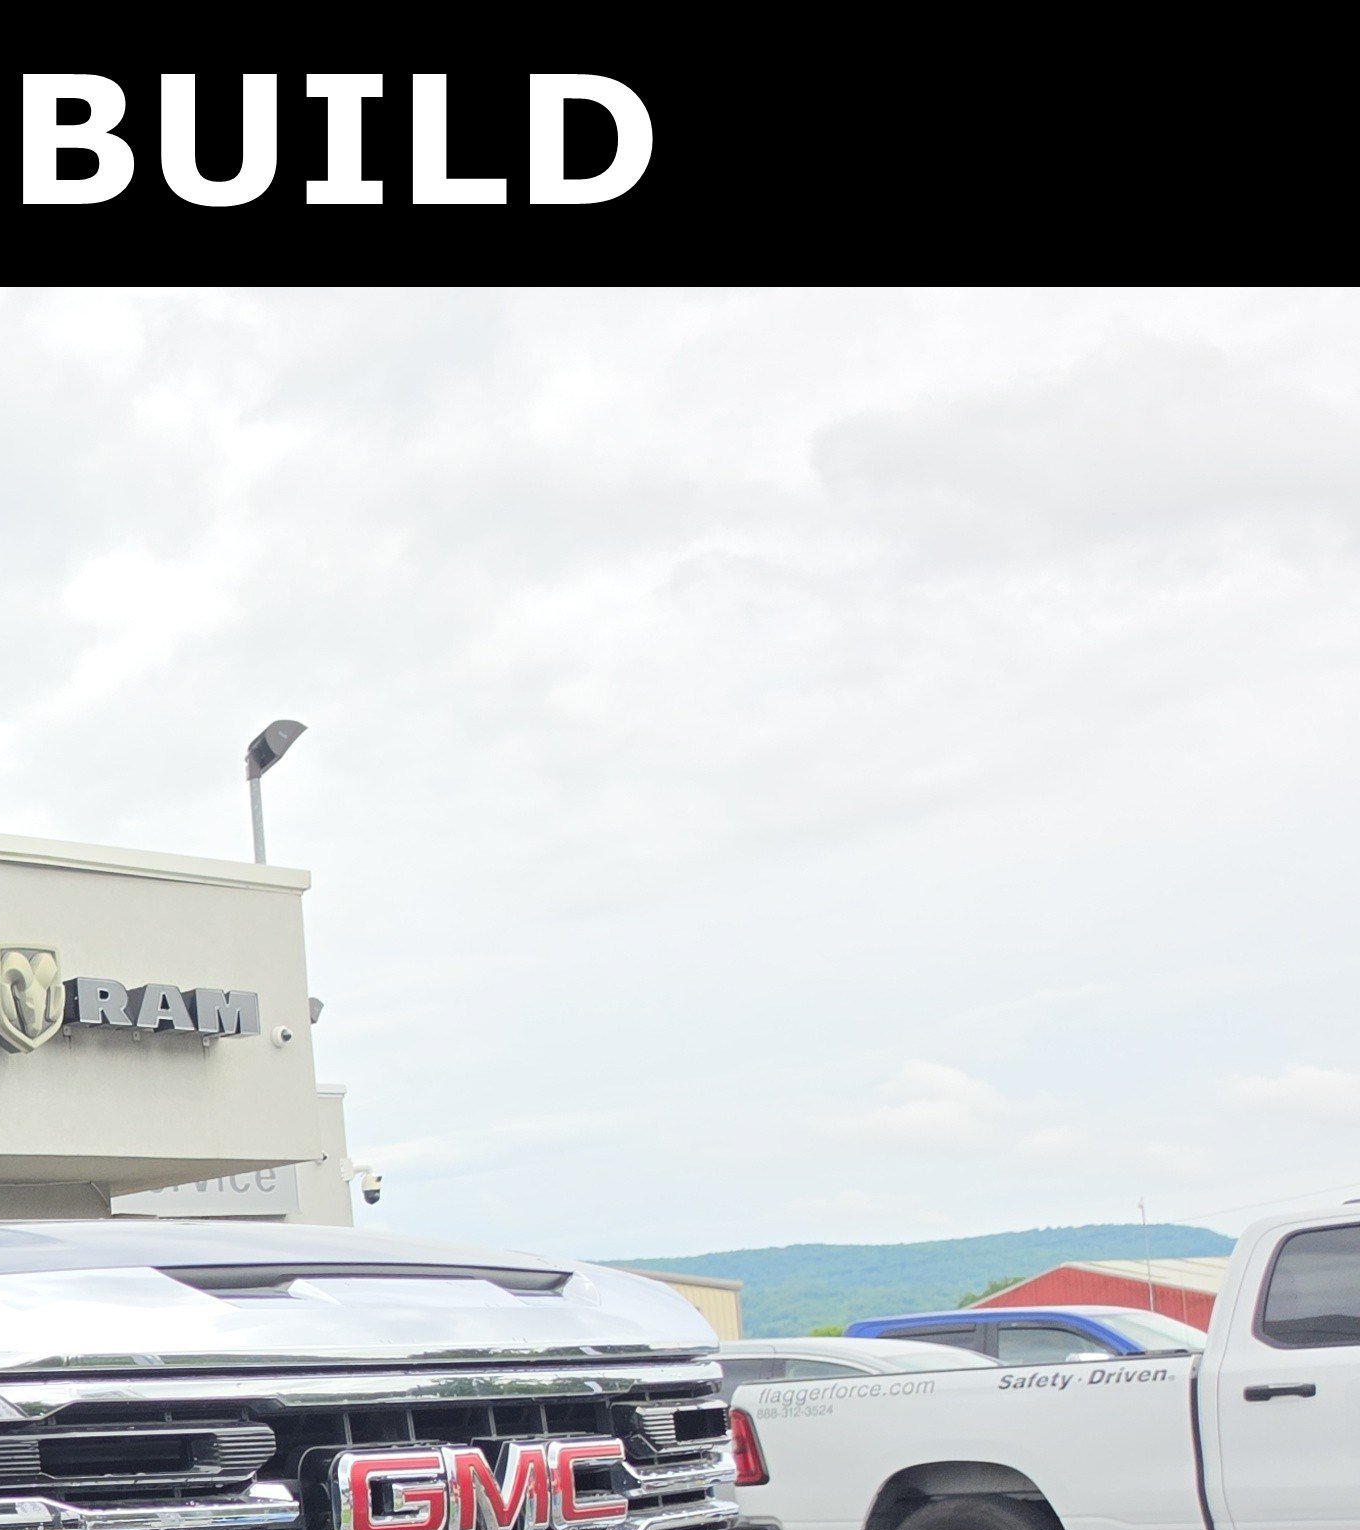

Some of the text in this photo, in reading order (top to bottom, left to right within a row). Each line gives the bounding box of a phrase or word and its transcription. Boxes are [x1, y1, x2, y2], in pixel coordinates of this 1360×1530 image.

[65, 976, 261, 1037] RAM
[758, 1379, 936, 1407] flaggerforce.com
[998, 1371, 1074, 1391] Safety
